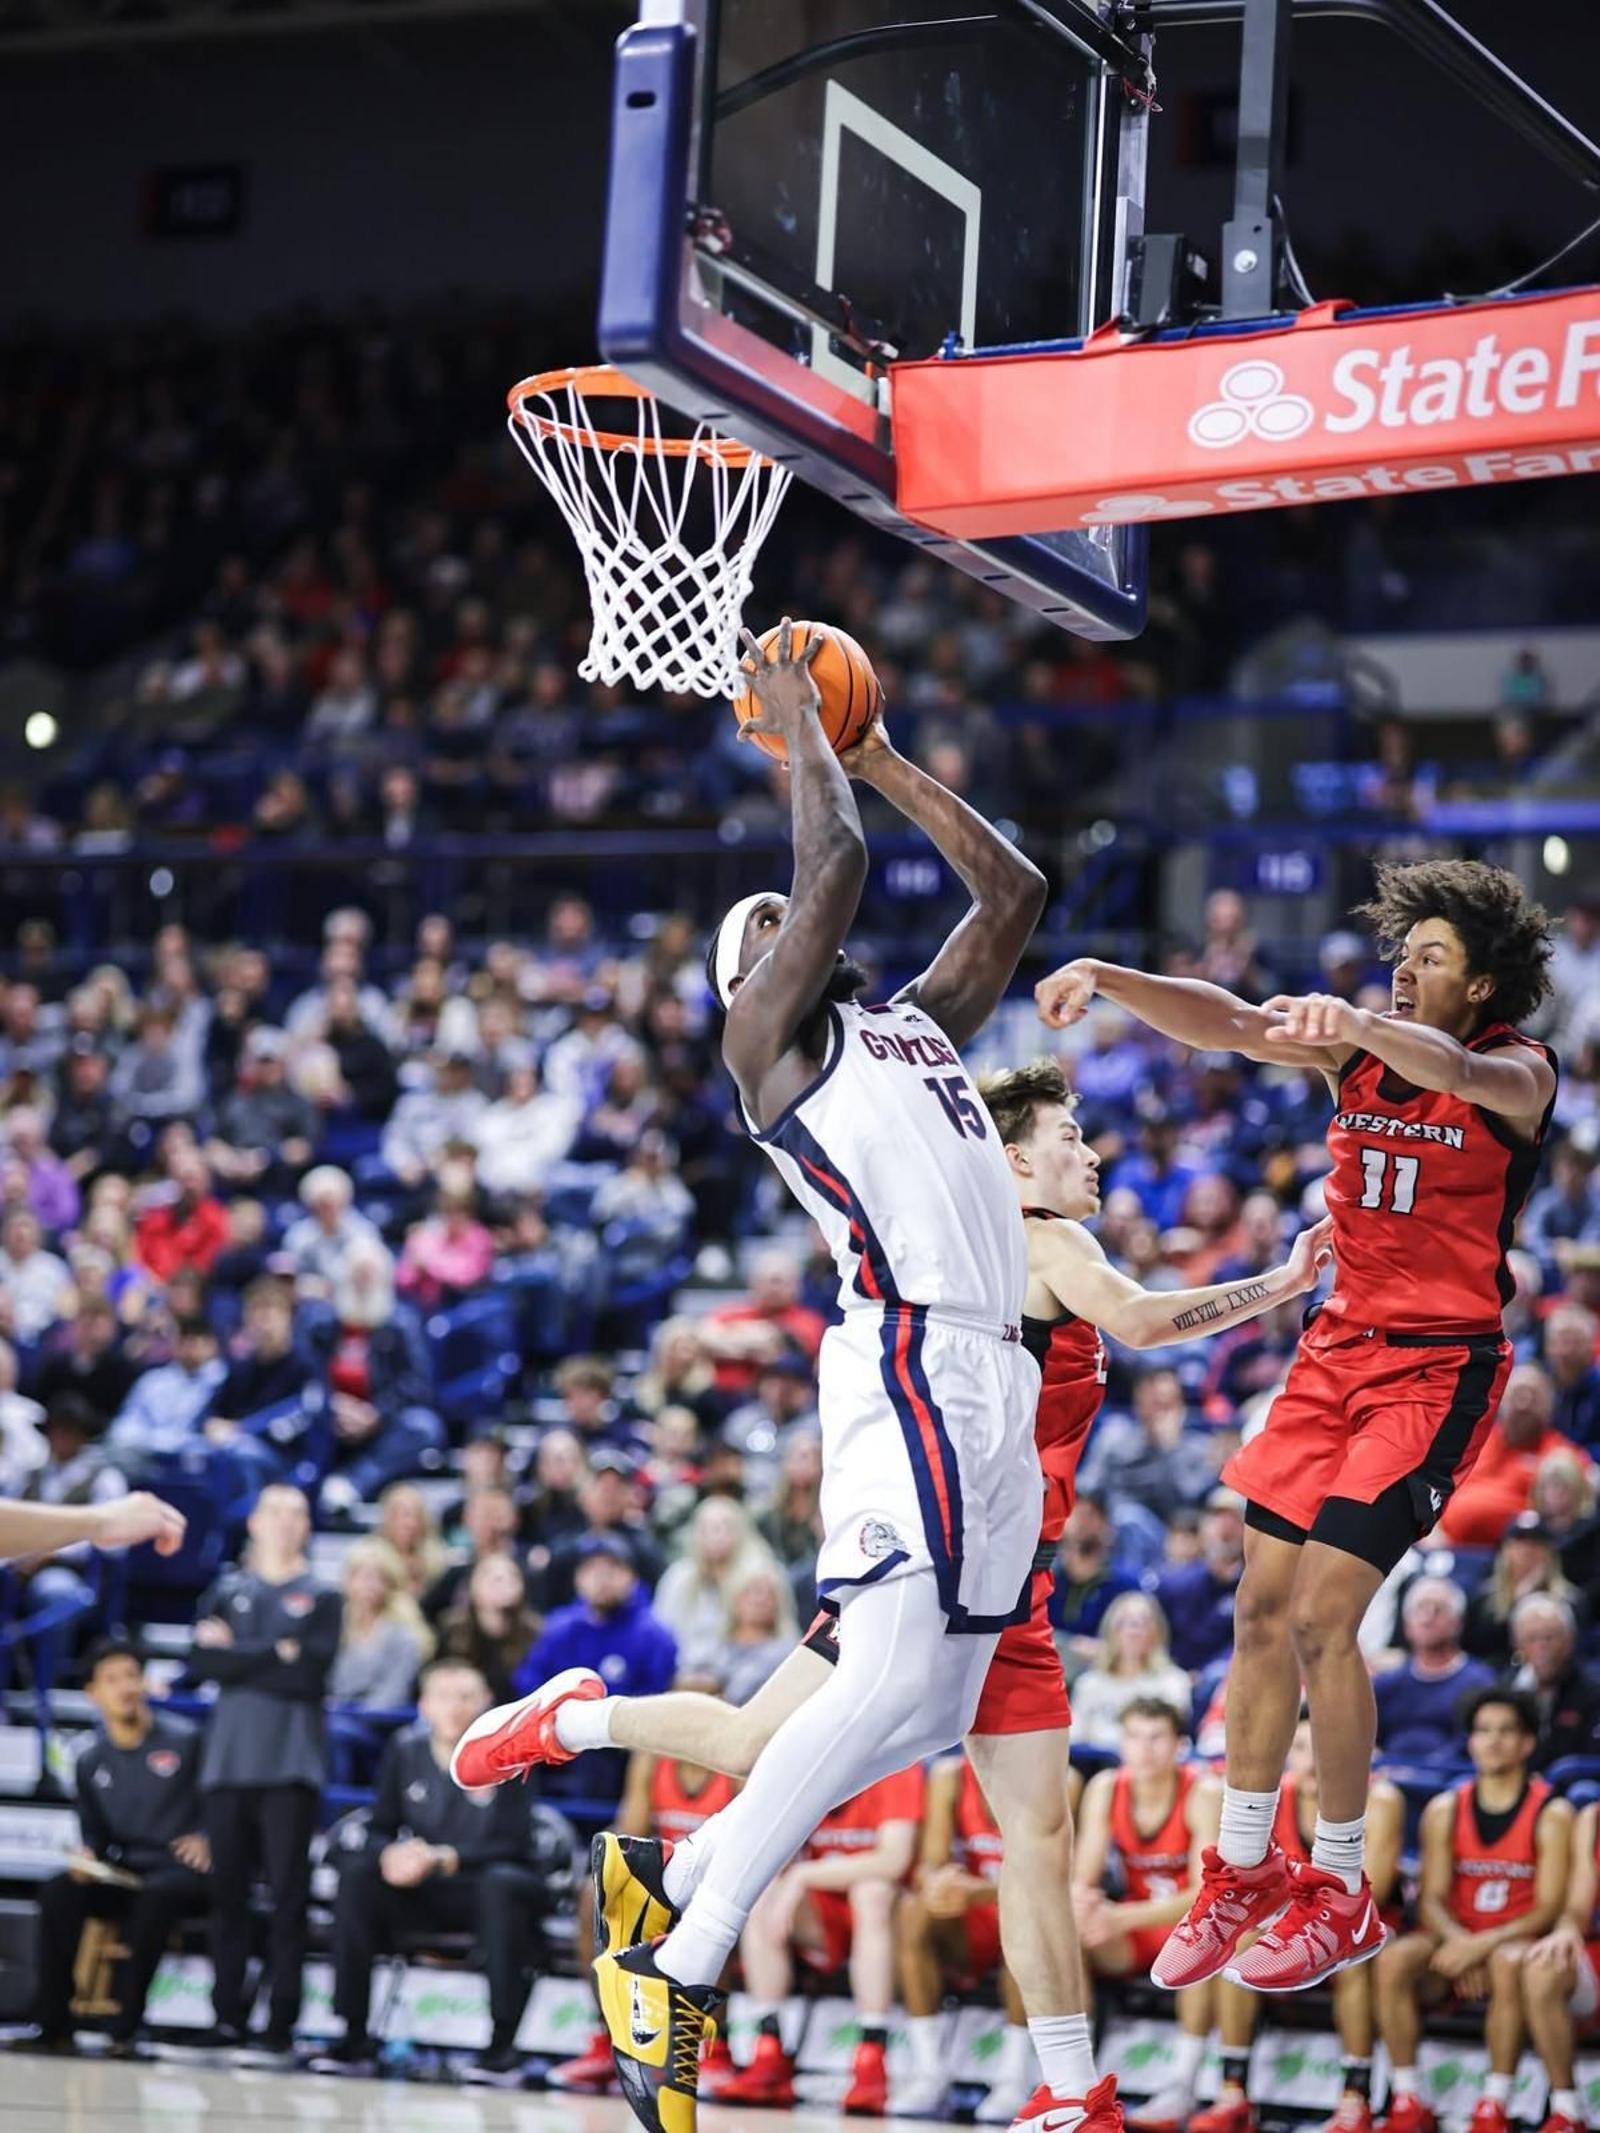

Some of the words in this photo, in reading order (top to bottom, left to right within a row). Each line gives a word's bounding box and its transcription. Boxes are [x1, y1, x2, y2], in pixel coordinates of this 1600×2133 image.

[1556, 319, 1600, 408] F
[1216, 466, 1459, 508] State
[1464, 449, 1600, 483] Far
[922, 1075, 987, 1141] 15
[1360, 1147, 1420, 1215] 11
